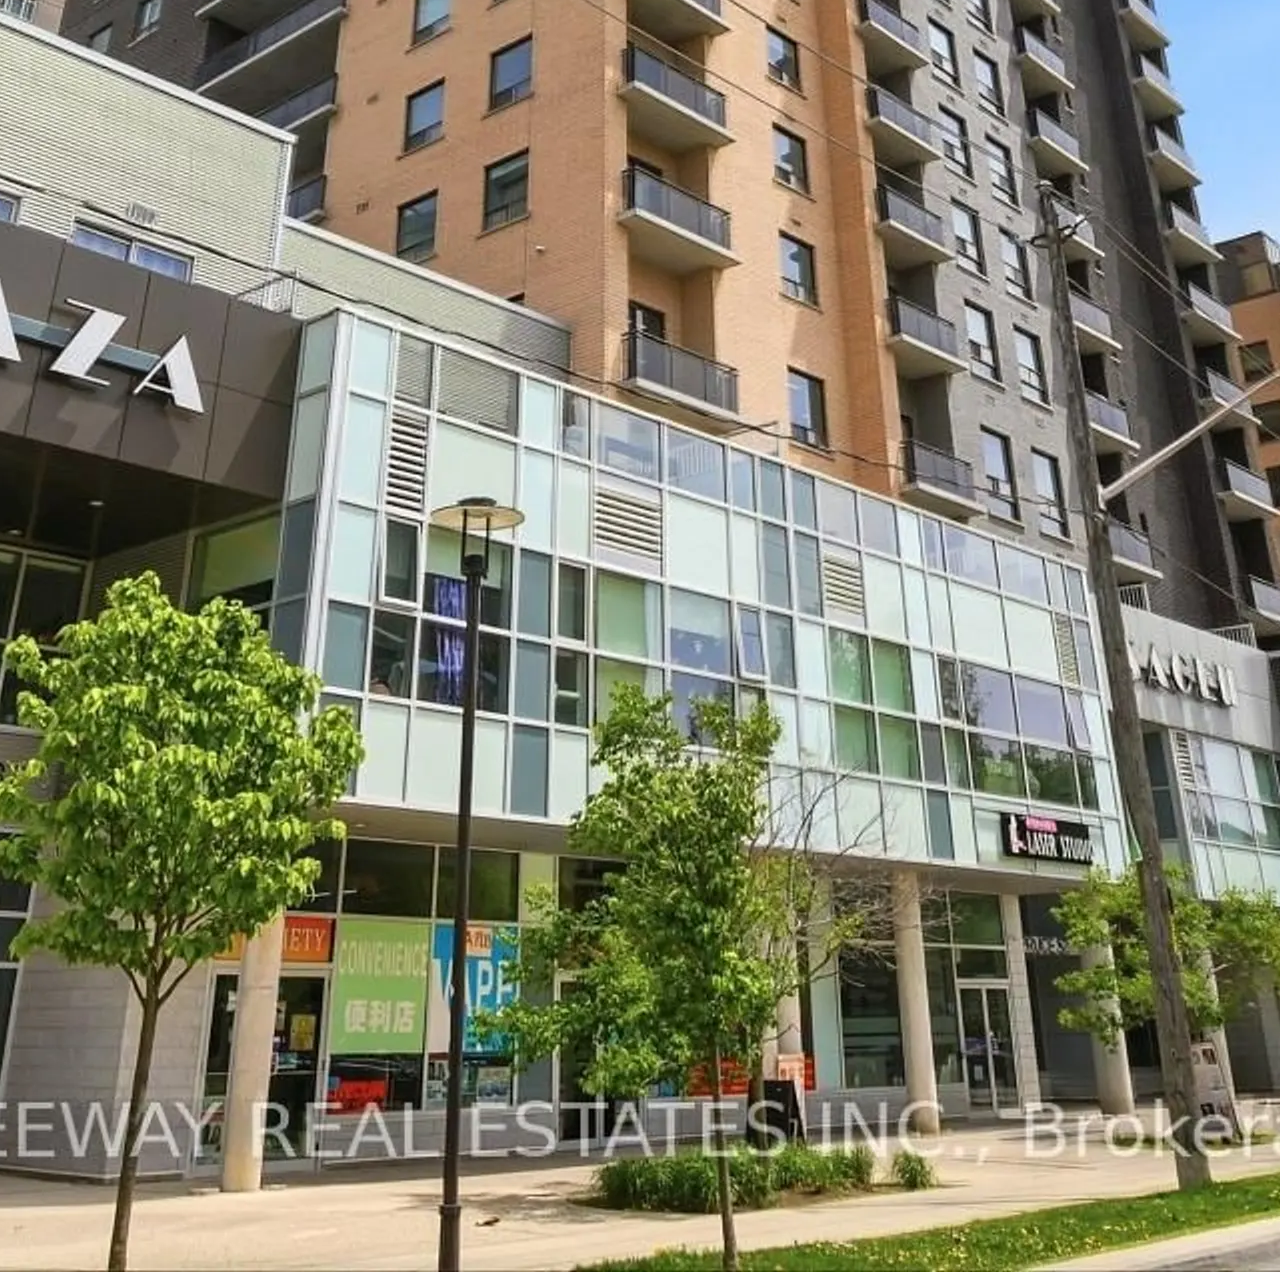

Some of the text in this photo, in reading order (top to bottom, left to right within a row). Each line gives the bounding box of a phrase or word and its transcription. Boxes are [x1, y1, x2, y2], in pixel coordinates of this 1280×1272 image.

[338, 939, 428, 977] CONVENIENCE
[344, 998, 416, 1034] 便利店
